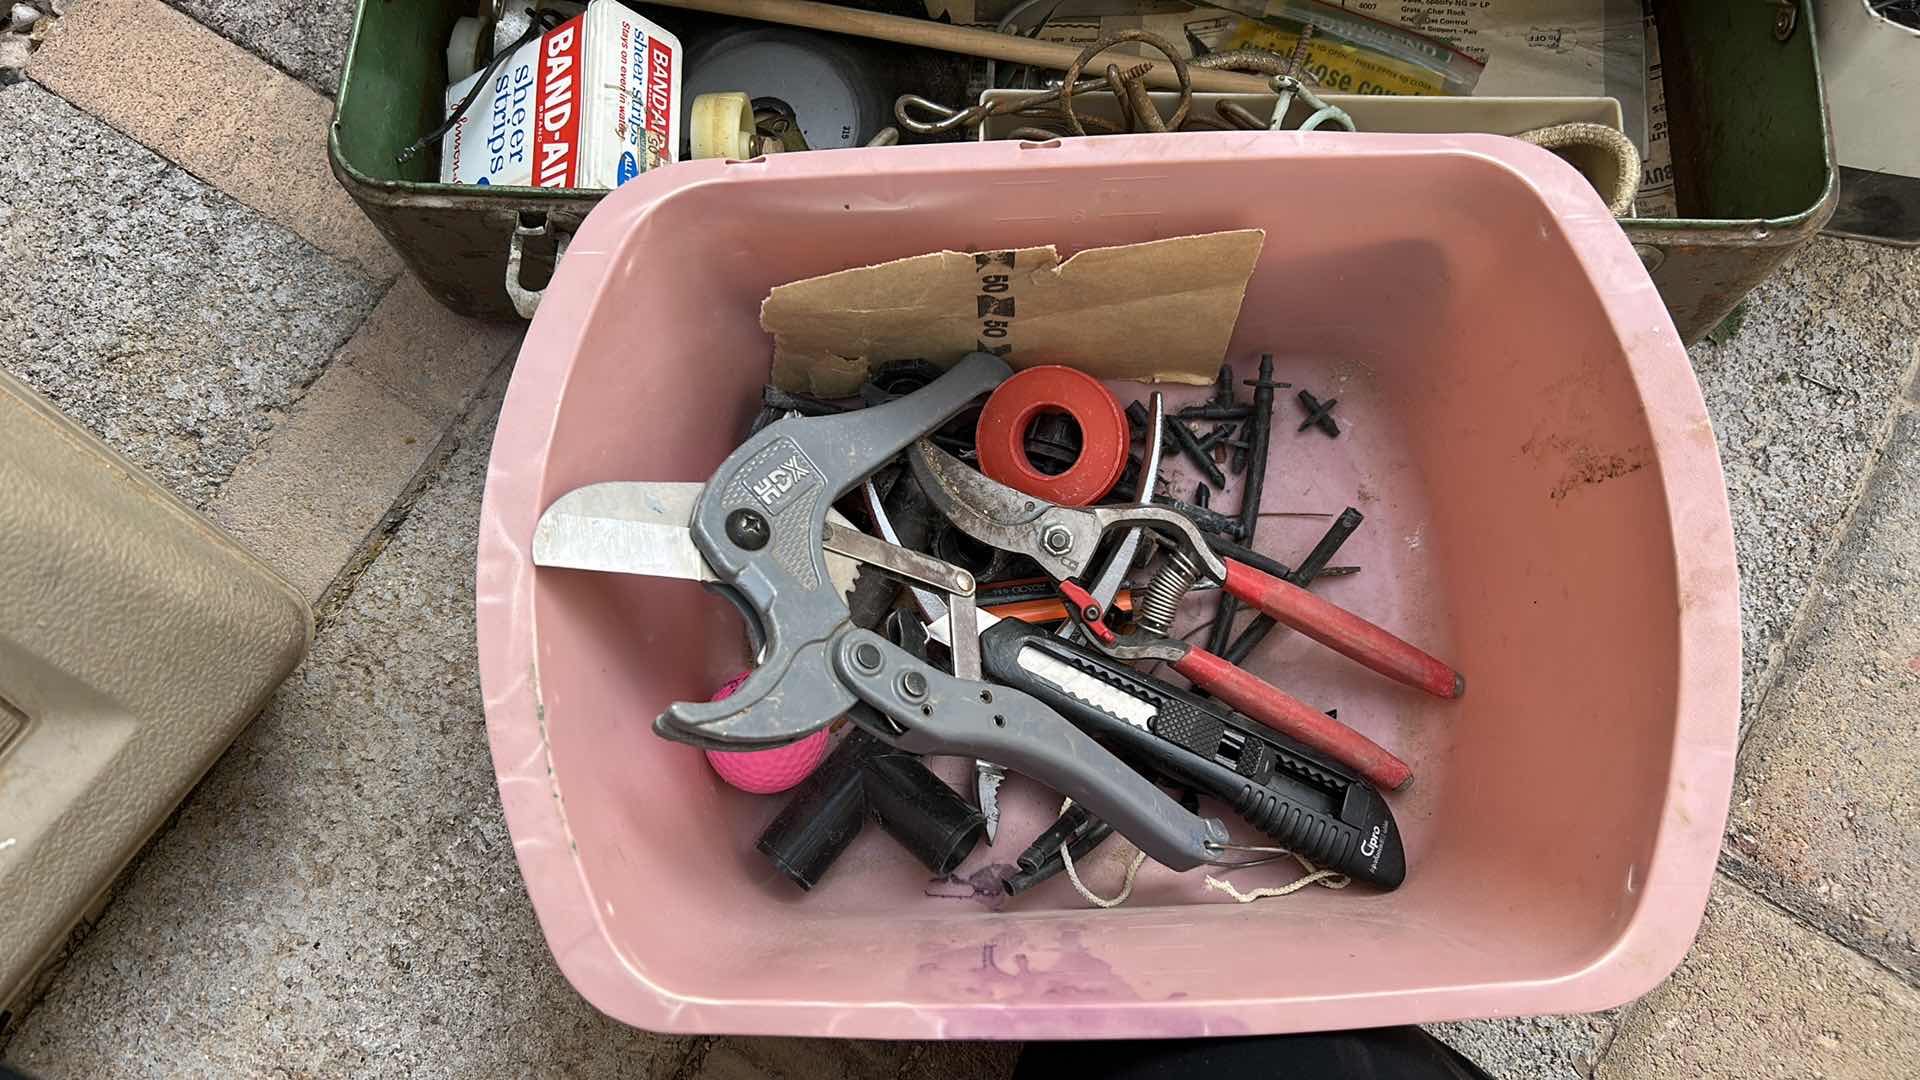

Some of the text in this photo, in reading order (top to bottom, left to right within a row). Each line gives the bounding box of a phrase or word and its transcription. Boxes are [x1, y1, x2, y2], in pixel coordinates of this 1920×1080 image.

[620, 20, 631, 49] Stays
[620, 50, 628, 65] on
[632, 27, 647, 85] sheer
[619, 66, 628, 92] even
[619, 93, 628, 104] in
[451, 97, 469, 172] Jhnson
[487, 74, 510, 175] strips
[509, 64, 534, 164] sheer
[628, 87, 644, 145] strips
[1644, 164, 1673, 185] BUY
[982, 274, 1009, 338] 50 50
[752, 455, 809, 505] HDX
